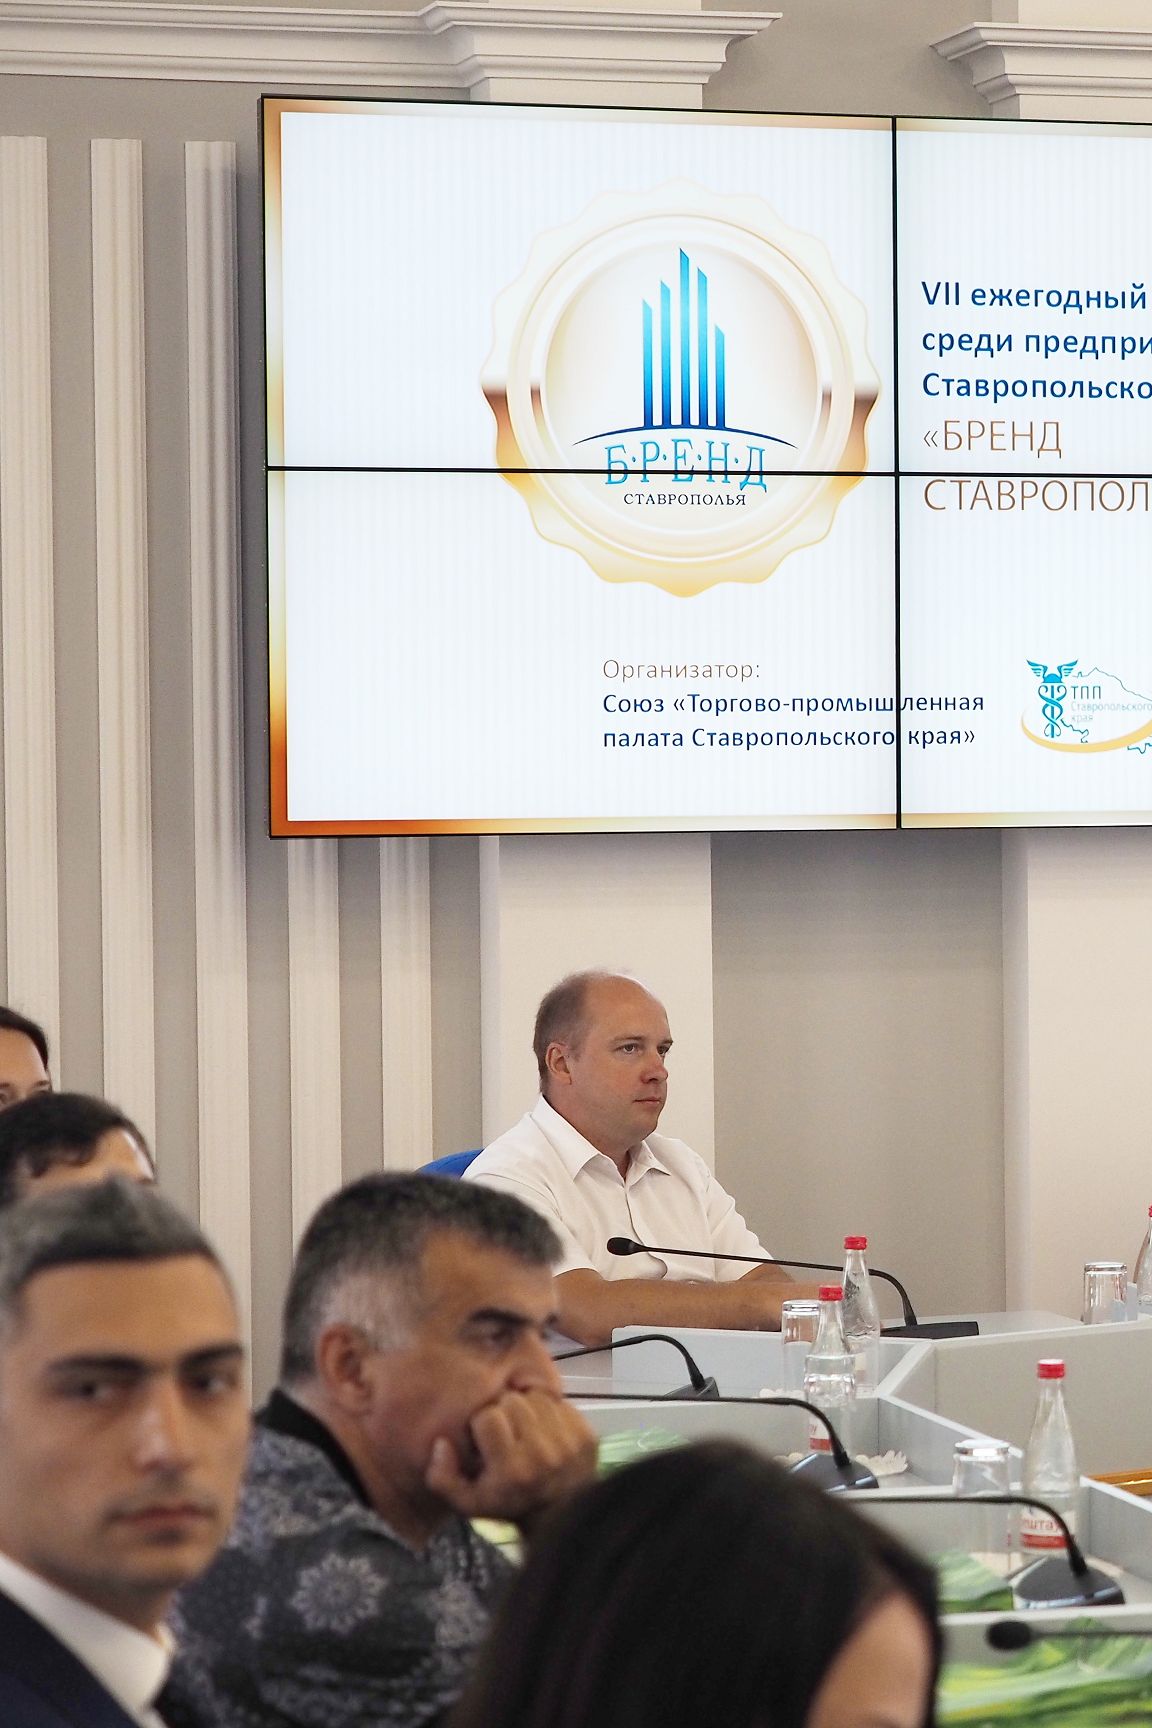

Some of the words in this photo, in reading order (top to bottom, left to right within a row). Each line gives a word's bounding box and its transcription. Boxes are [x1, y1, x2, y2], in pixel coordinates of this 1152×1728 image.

[921, 281, 961, 306] VII
[970, 282, 1147, 314] ежегодный
[922, 331, 1013, 359] среди
[923, 420, 1062, 459] «БРЕНД
[623, 493, 747, 506] СТАВРОПОЛЬЯ
[602, 659, 761, 683] Организатор:
[1071, 685, 1102, 700] ТПП
[603, 694, 665, 713] Союз
[673, 693, 985, 716] «Торгово-промышленная
[1071, 701, 1152, 713] Ставропольского
[603, 732, 684, 748] палата
[692, 728, 896, 751] Ставропольского
[908, 728, 976, 750] края»
